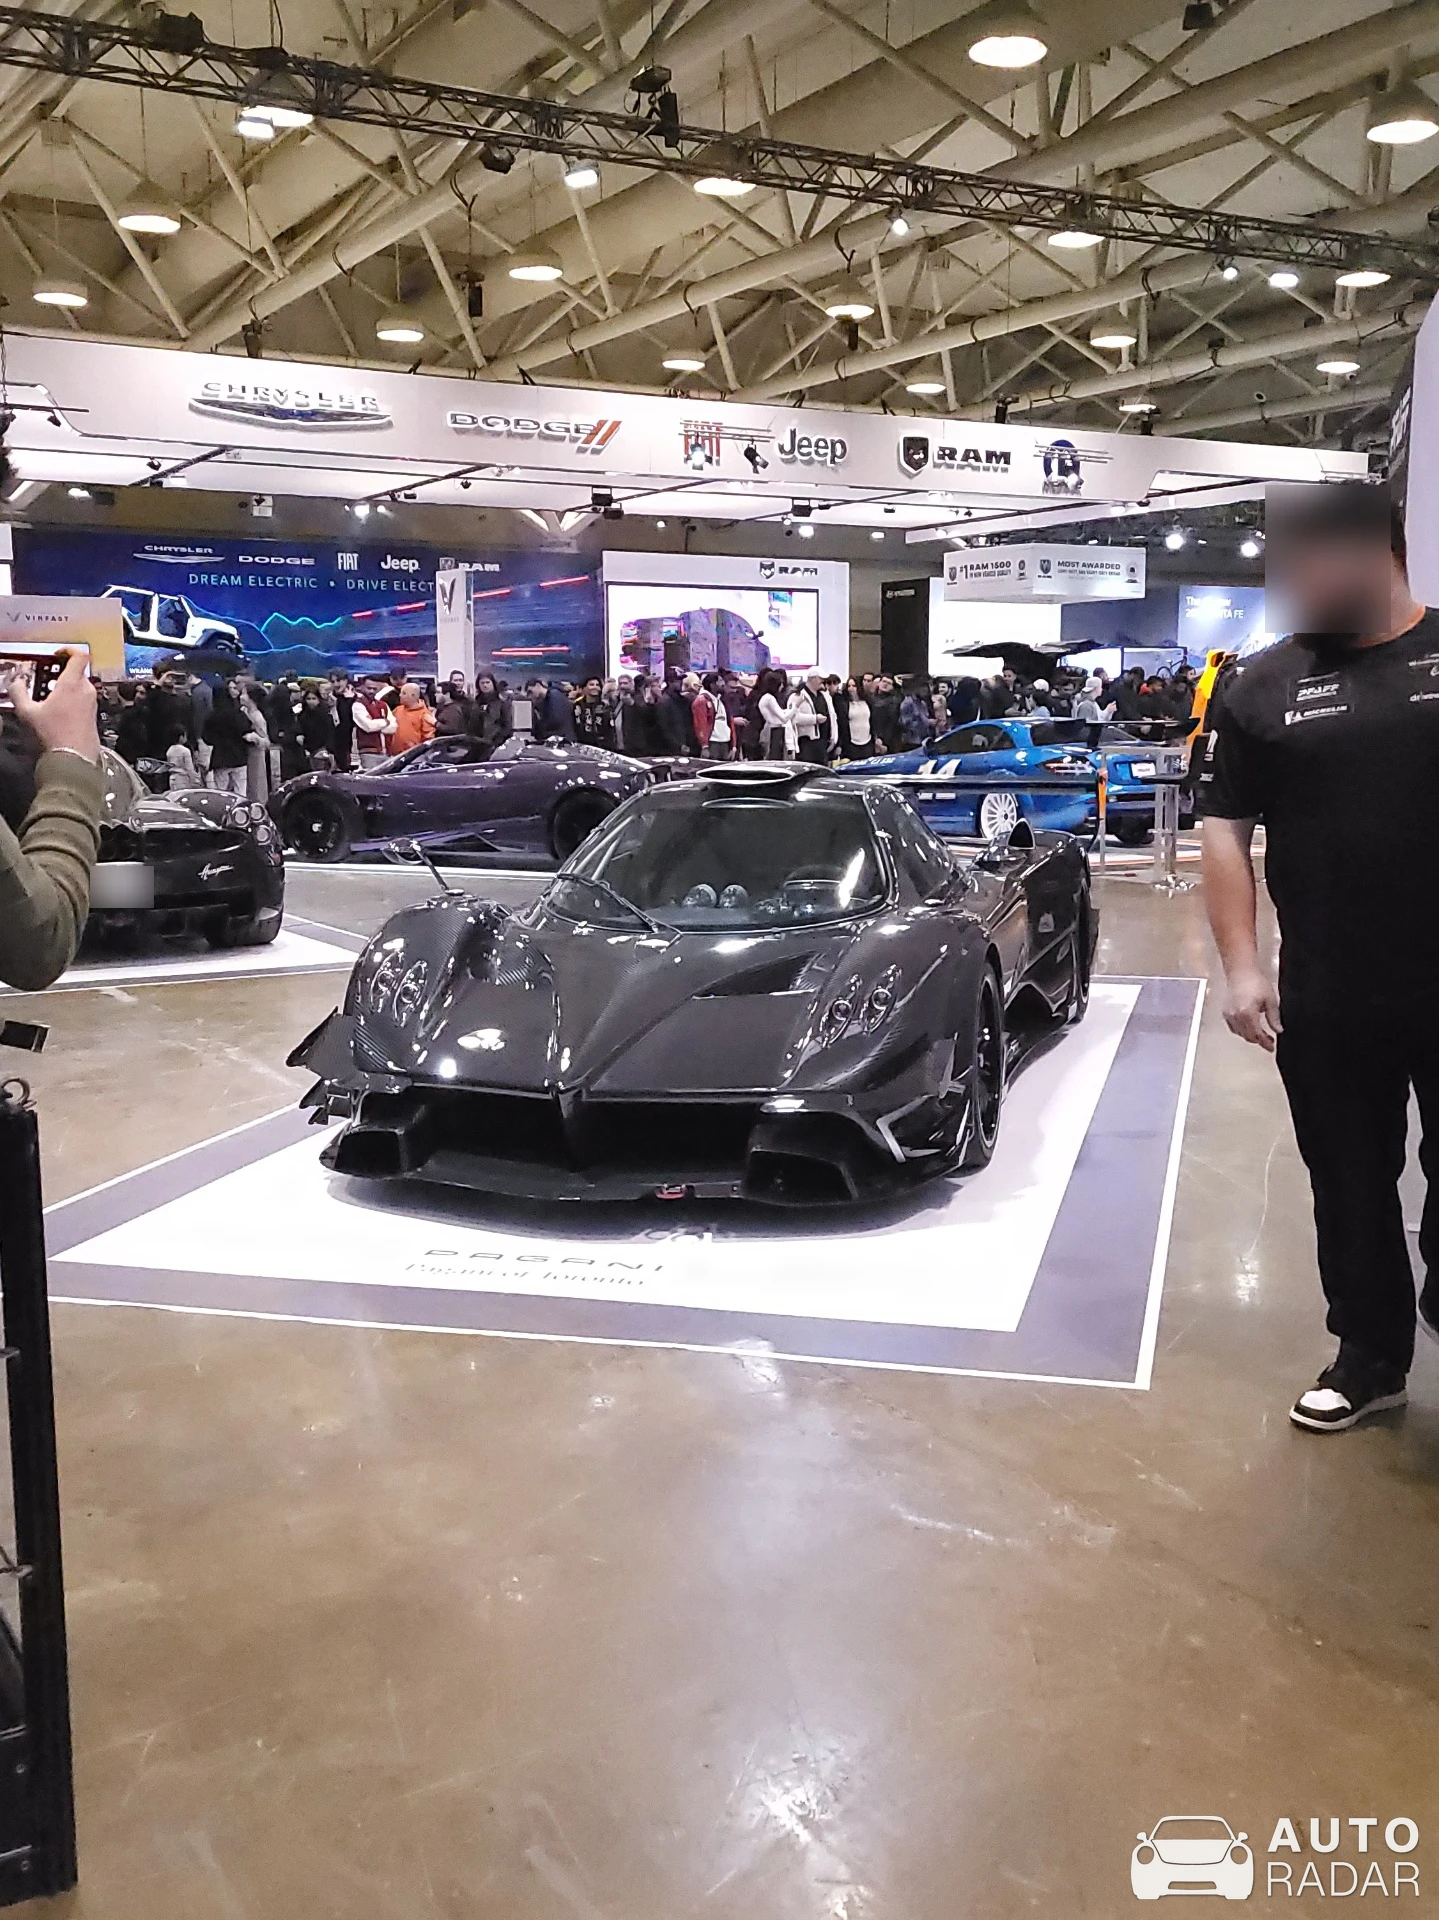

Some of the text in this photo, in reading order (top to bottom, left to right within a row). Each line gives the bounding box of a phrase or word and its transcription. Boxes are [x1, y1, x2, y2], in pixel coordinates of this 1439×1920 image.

[202, 382, 378, 408] CHRYSLER
[449, 412, 599, 437] DODGE
[778, 427, 848, 465] Jeep
[936, 445, 1012, 466] RAM
[144, 544, 213, 554] CHRYSLER
[238, 555, 316, 565] DODGE
[337, 552, 359, 571] FIAT
[380, 554, 421, 573] Jeep
[458, 562, 500, 572] RAM
[969, 563, 989, 571] RAM
[990, 560, 1012, 569] 1500
[1057, 560, 1121, 570] MOST AWARDED
[778, 566, 818, 576] RAM
[188, 573, 318, 588] DREAM ELECTRIC
[346, 579, 434, 592] DRIVE ELECT
[25, 614, 70, 622] VINFAST
[424, 1249, 663, 1271] PAGANI
